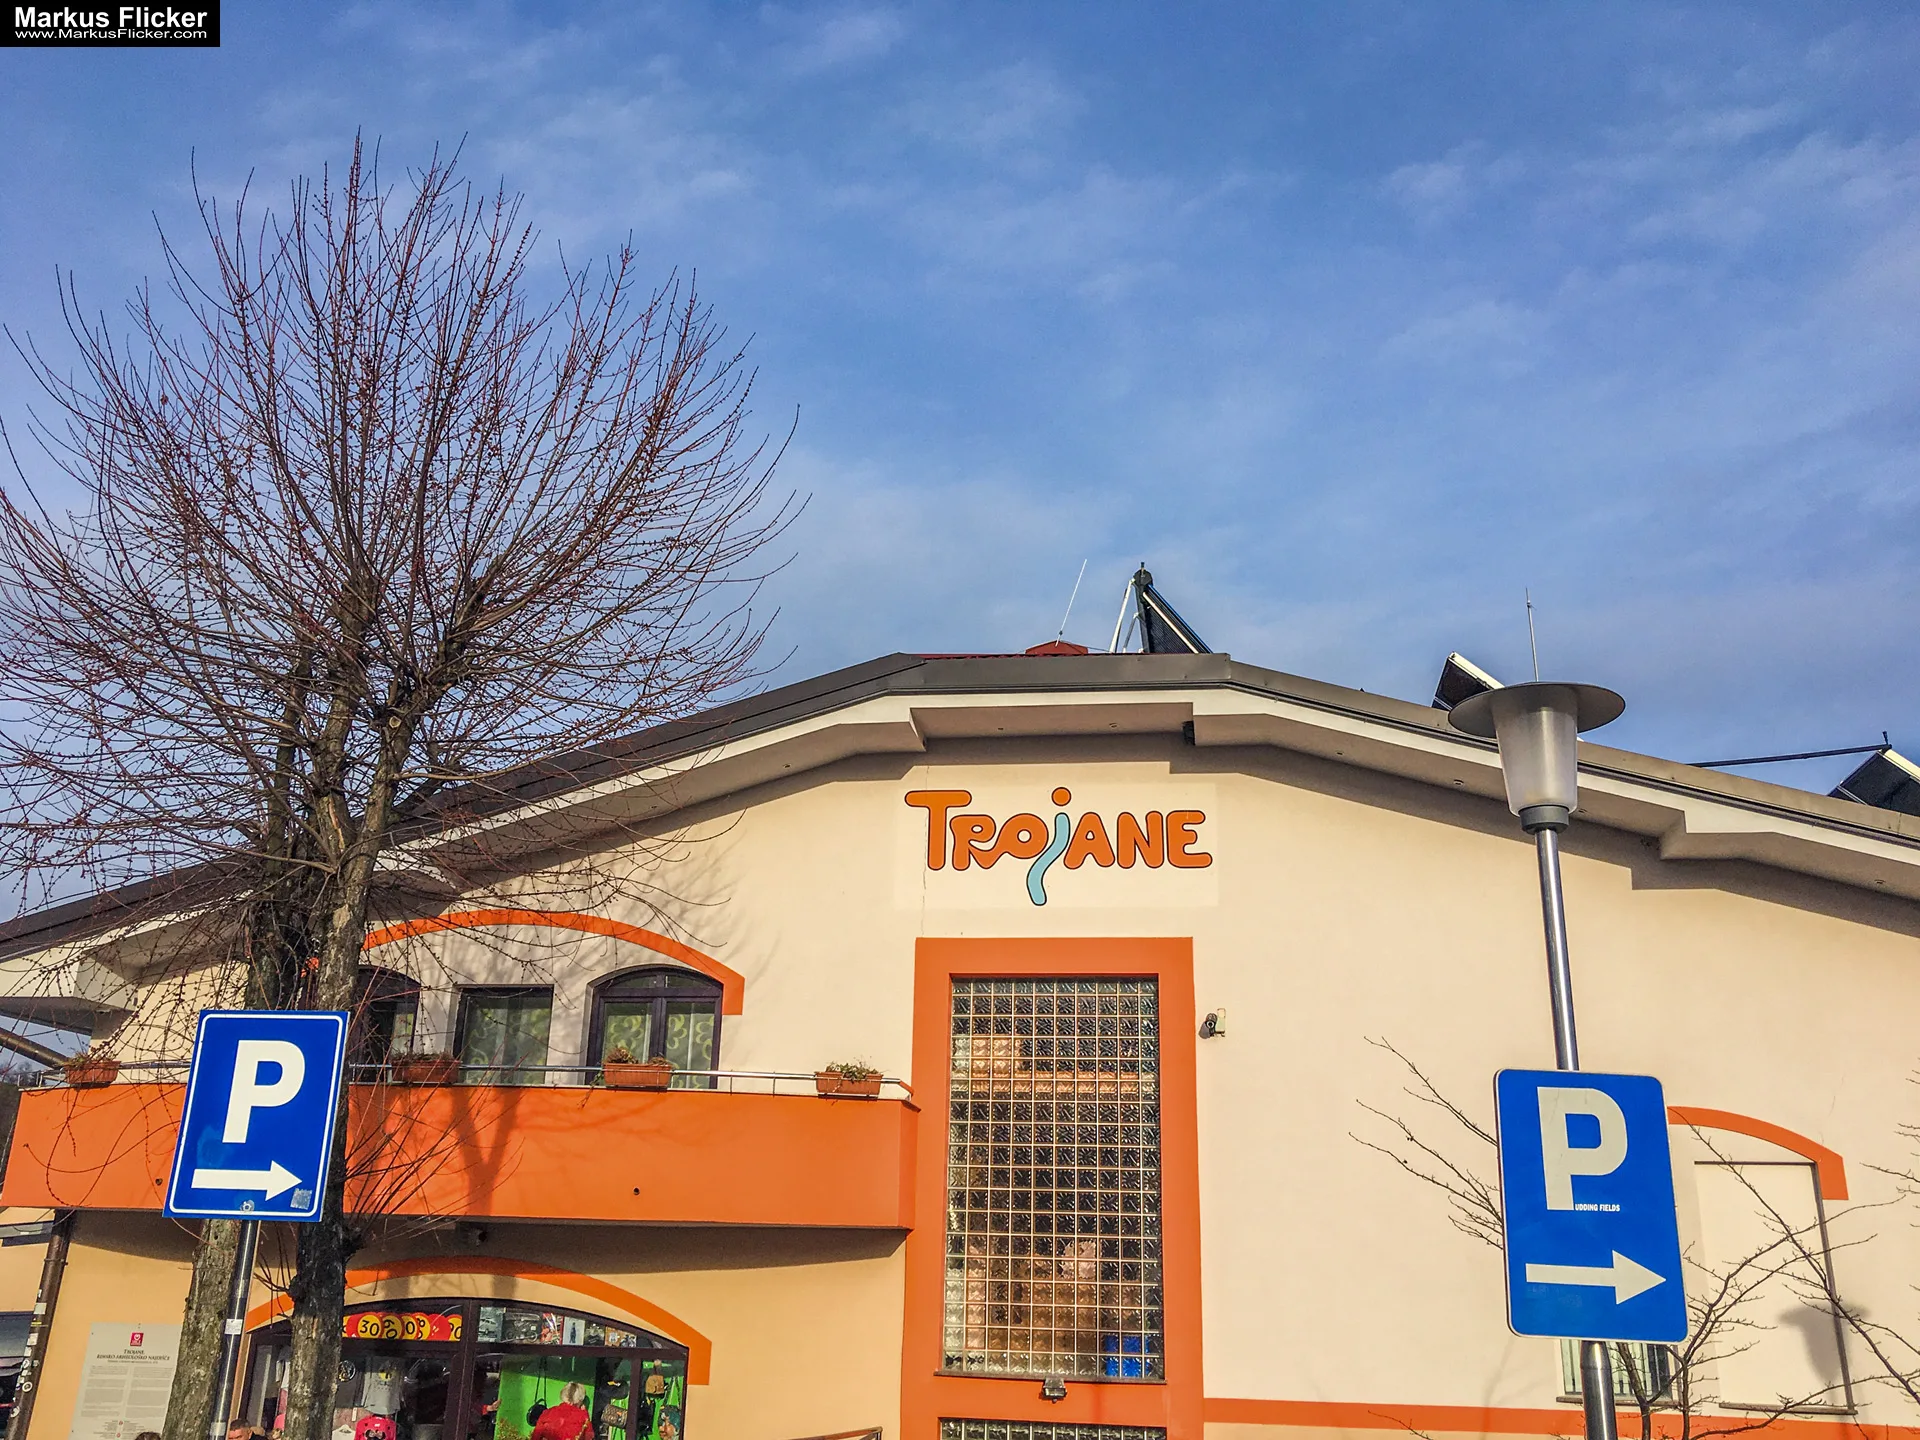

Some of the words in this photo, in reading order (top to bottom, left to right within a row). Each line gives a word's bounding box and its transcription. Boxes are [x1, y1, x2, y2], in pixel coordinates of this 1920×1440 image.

[222, 1040, 305, 1144] P
[1537, 1086, 1628, 1210] P
[1575, 1203, 1598, 1211] UDDING
[1599, 1204, 1620, 1212] FIELDS
[359, 1319, 380, 1336] 30
